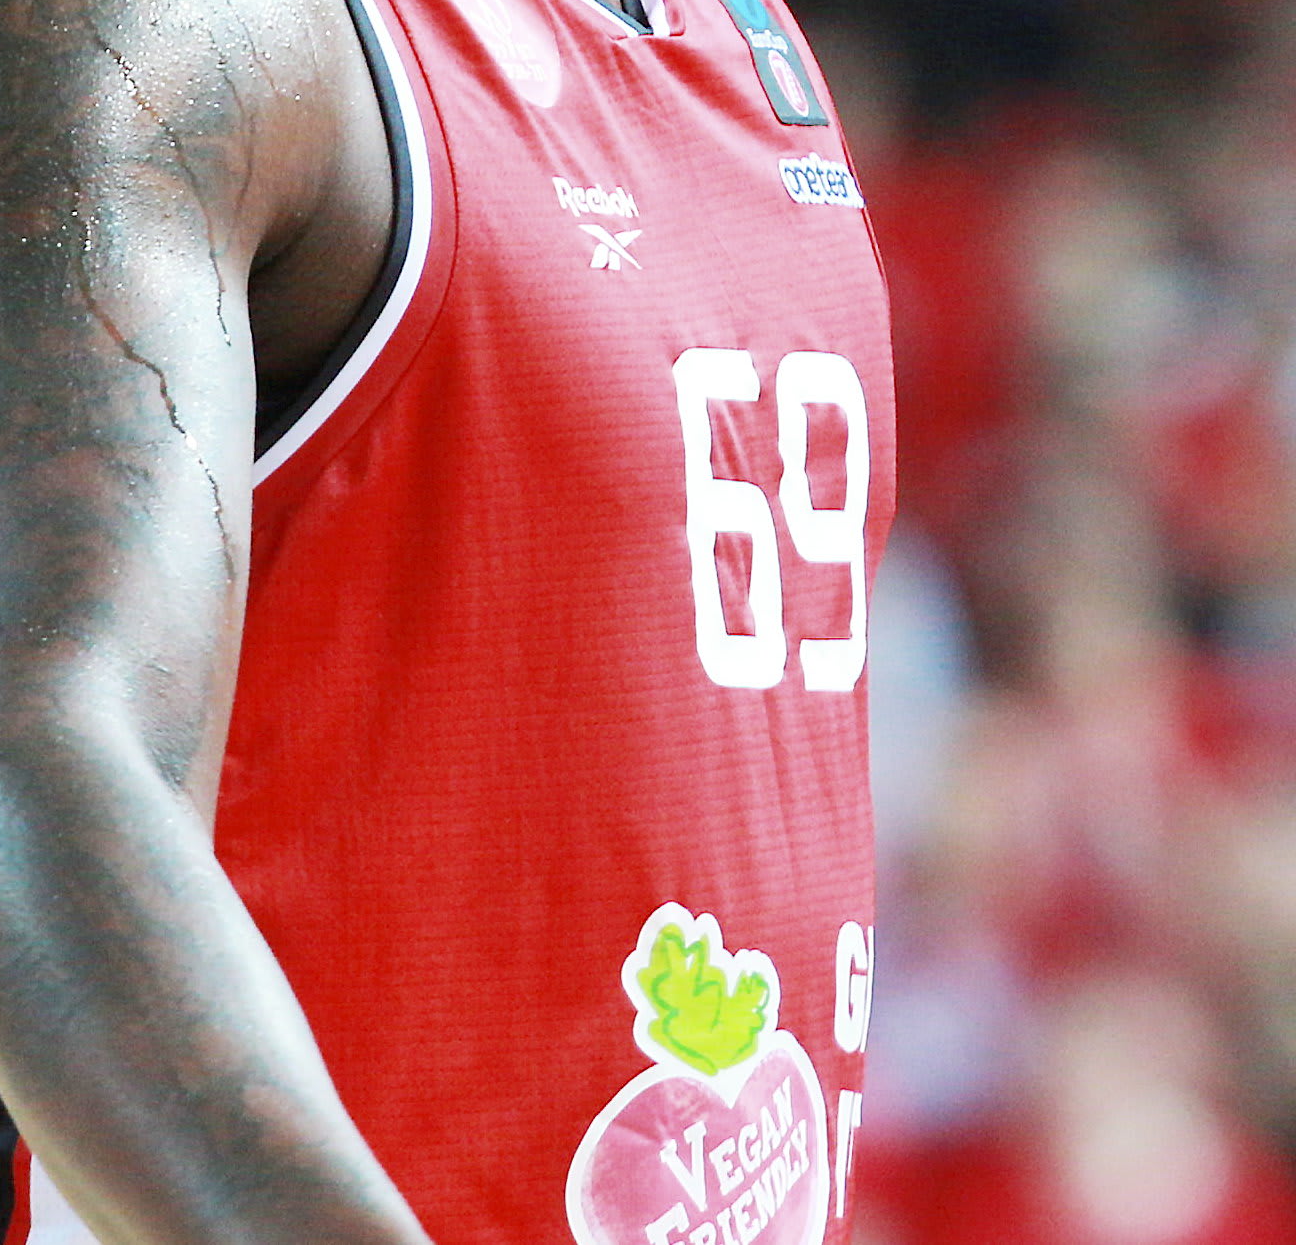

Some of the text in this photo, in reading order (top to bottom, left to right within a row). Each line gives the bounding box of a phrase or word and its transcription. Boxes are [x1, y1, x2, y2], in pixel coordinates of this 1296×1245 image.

[551, 176, 640, 219] Reebok
[783, 164, 854, 200] onetea
[671, 346, 871, 692] 69
[659, 1075, 794, 1212] VEGAN
